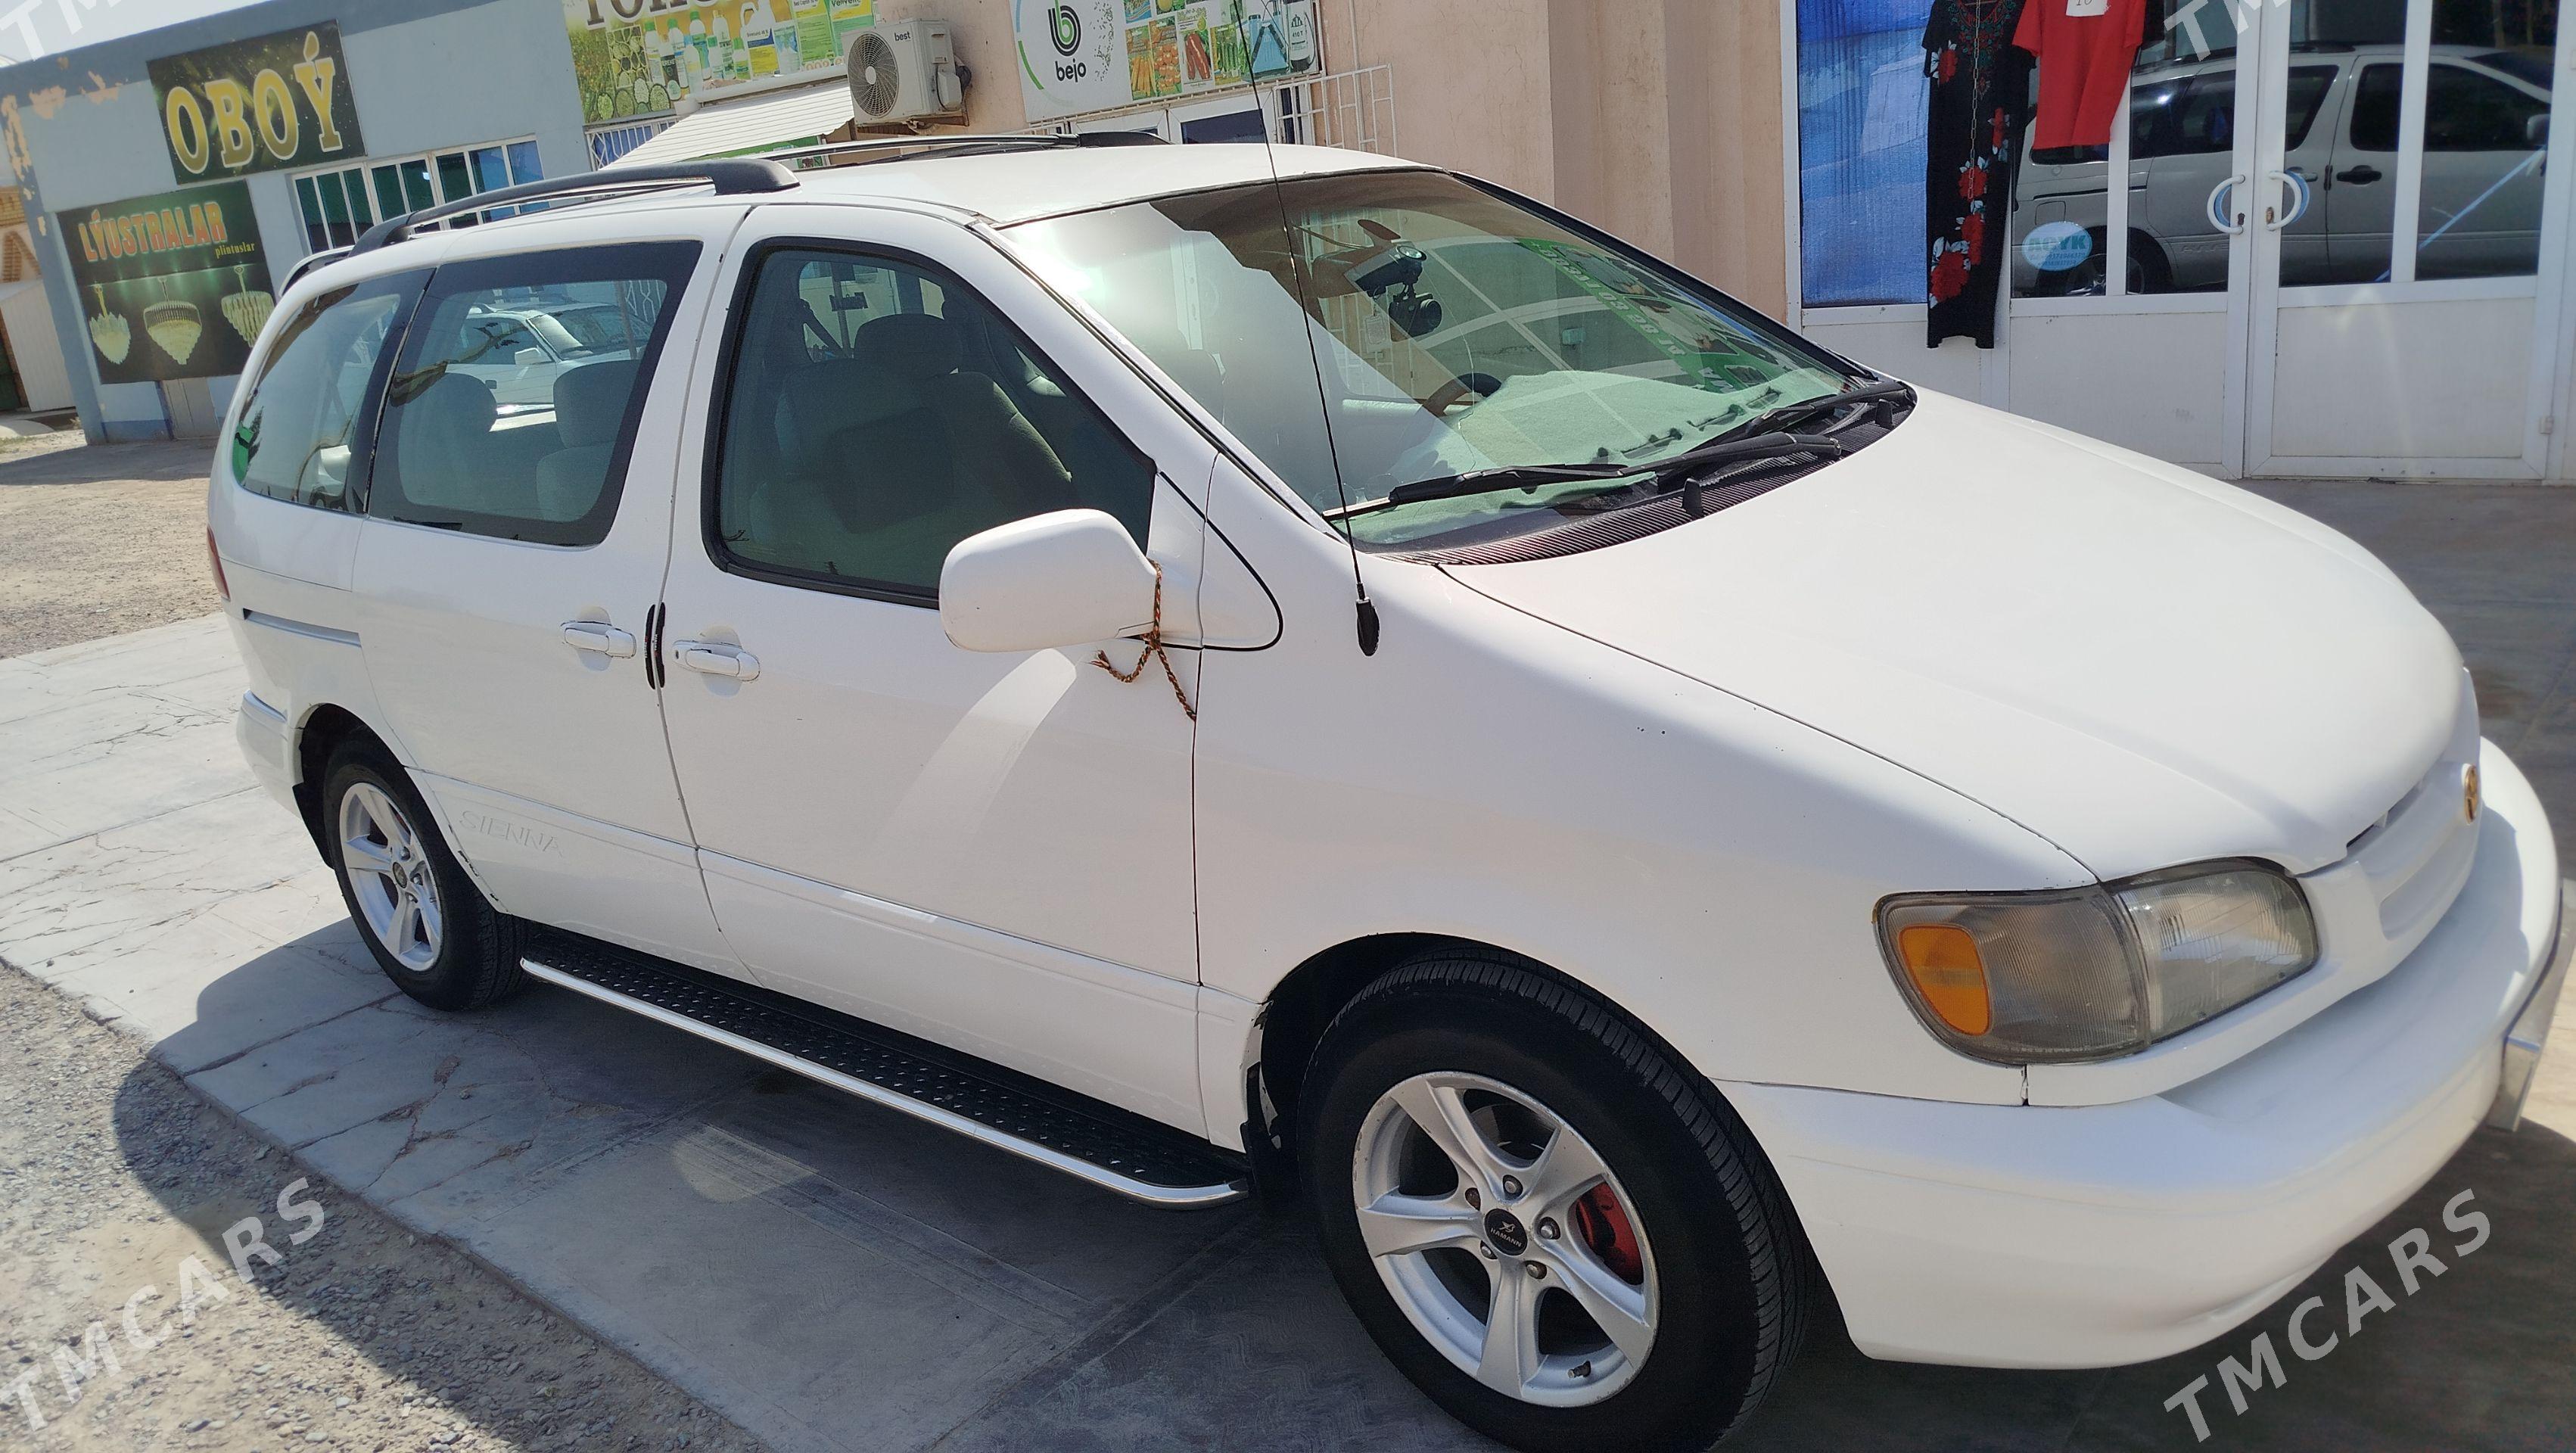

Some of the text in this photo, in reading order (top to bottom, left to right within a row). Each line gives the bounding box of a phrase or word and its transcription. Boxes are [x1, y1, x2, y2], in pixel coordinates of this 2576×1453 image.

[894, 31, 911, 42] best
[1055, 58, 1087, 83] bejo
[166, 31, 343, 174] OBOÝ
[78, 201, 228, 263] LÝUSTRALAR
[215, 241, 255, 260] plintuslar
[459, 810, 563, 857] SIENNA
[1490, 1227, 1522, 1247] HAMANN
